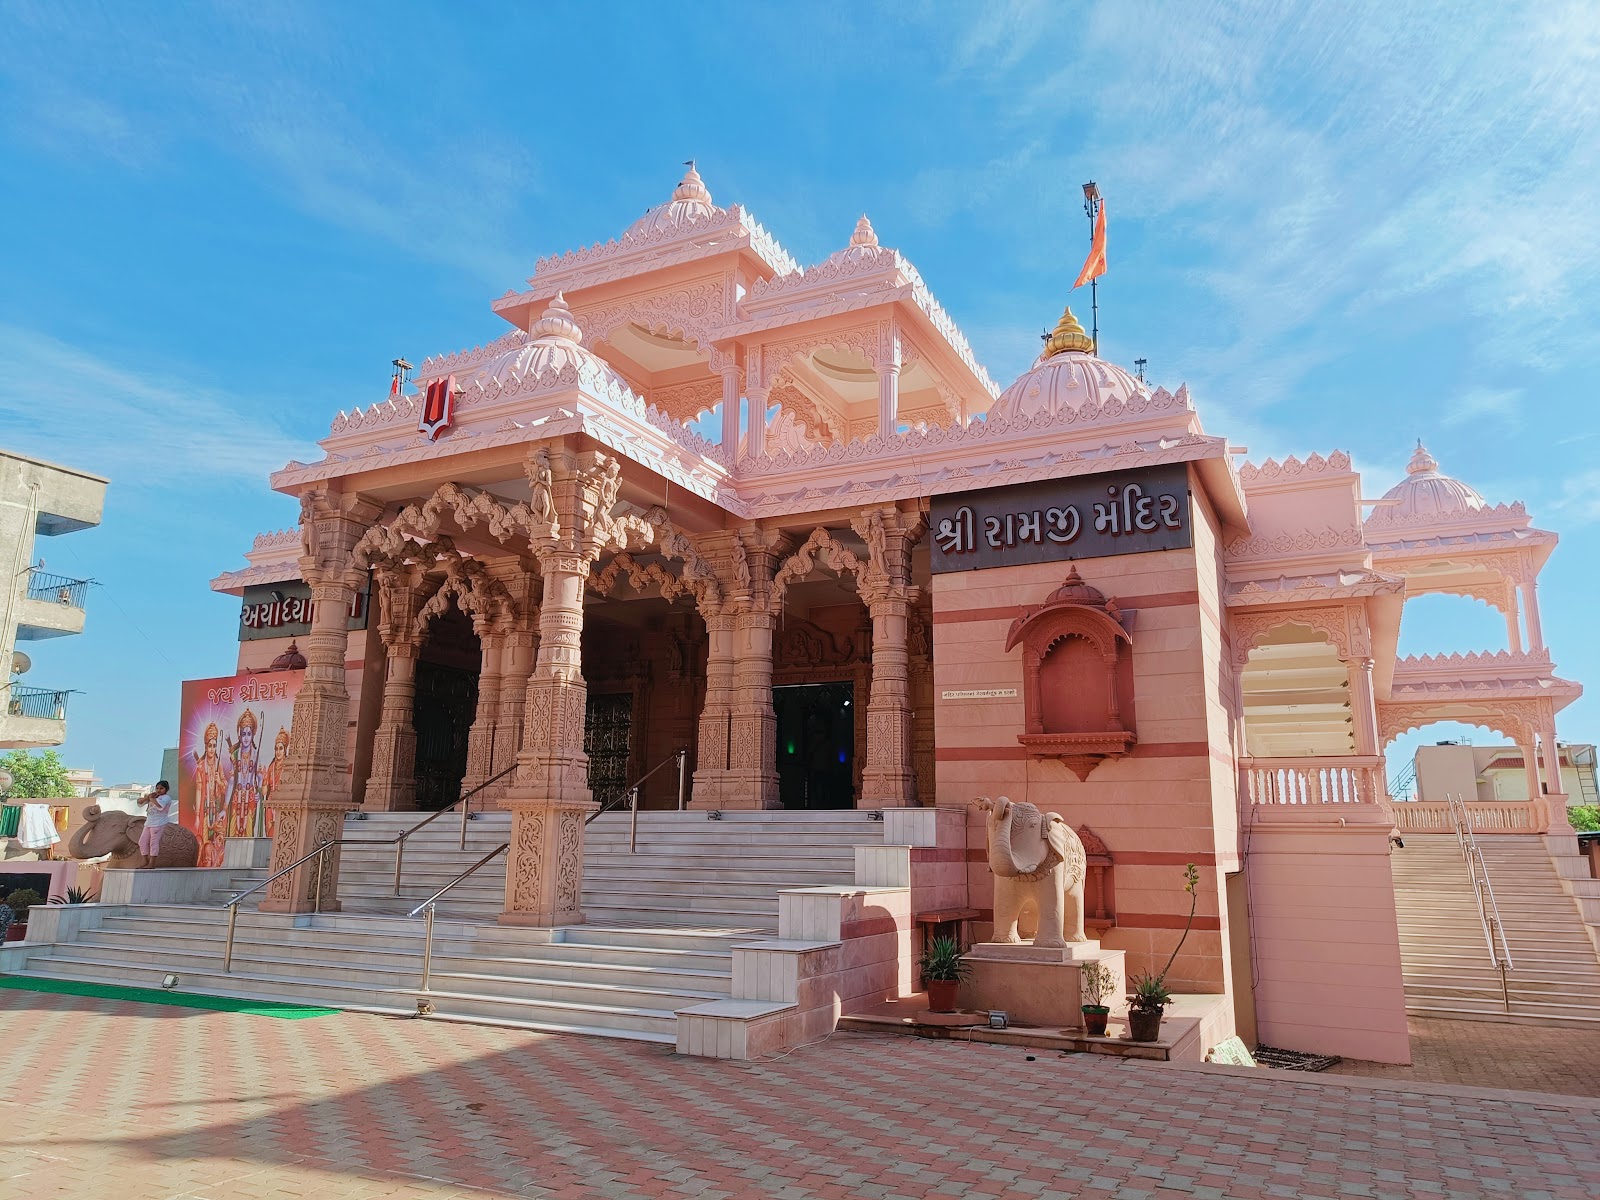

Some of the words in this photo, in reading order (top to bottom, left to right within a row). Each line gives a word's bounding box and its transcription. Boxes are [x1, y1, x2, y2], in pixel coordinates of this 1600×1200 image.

[935, 506, 974, 552] શ્રી
[985, 504, 1081, 547] રામજી
[1093, 483, 1181, 535] મંદિર
[208, 687, 234, 705] જય
